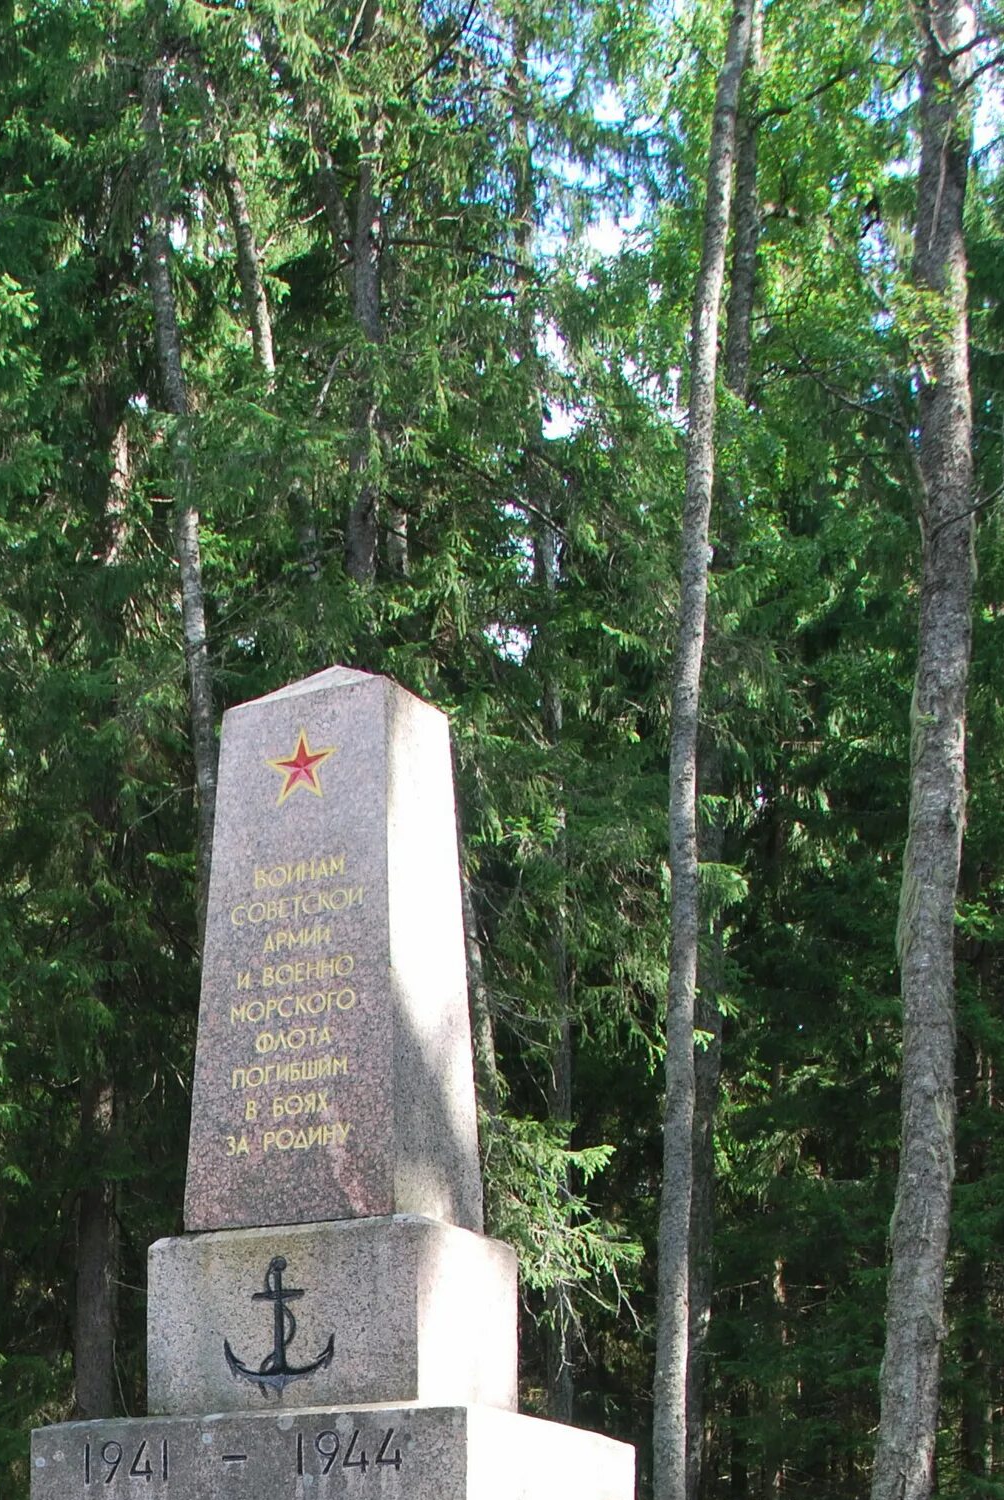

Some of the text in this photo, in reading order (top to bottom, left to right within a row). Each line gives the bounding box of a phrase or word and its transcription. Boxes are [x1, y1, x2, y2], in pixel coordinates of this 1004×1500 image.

[255, 854, 346, 889] ВОИНАМ
[263, 926, 332, 953] АРМИИ
[237, 955, 354, 989] И ВОЕННО
[231, 988, 356, 1023] МОРСКОГО
[256, 1027, 331, 1053] ФЛОТА
[232, 1056, 347, 1089] ПОГИБШИМ
[245, 1089, 328, 1119] В БОЯХ
[226, 1123, 351, 1155] ЗА РОДИНУ
[84, 1439, 168, 1485] 1941
[297, 1428, 403, 1476] 1944
